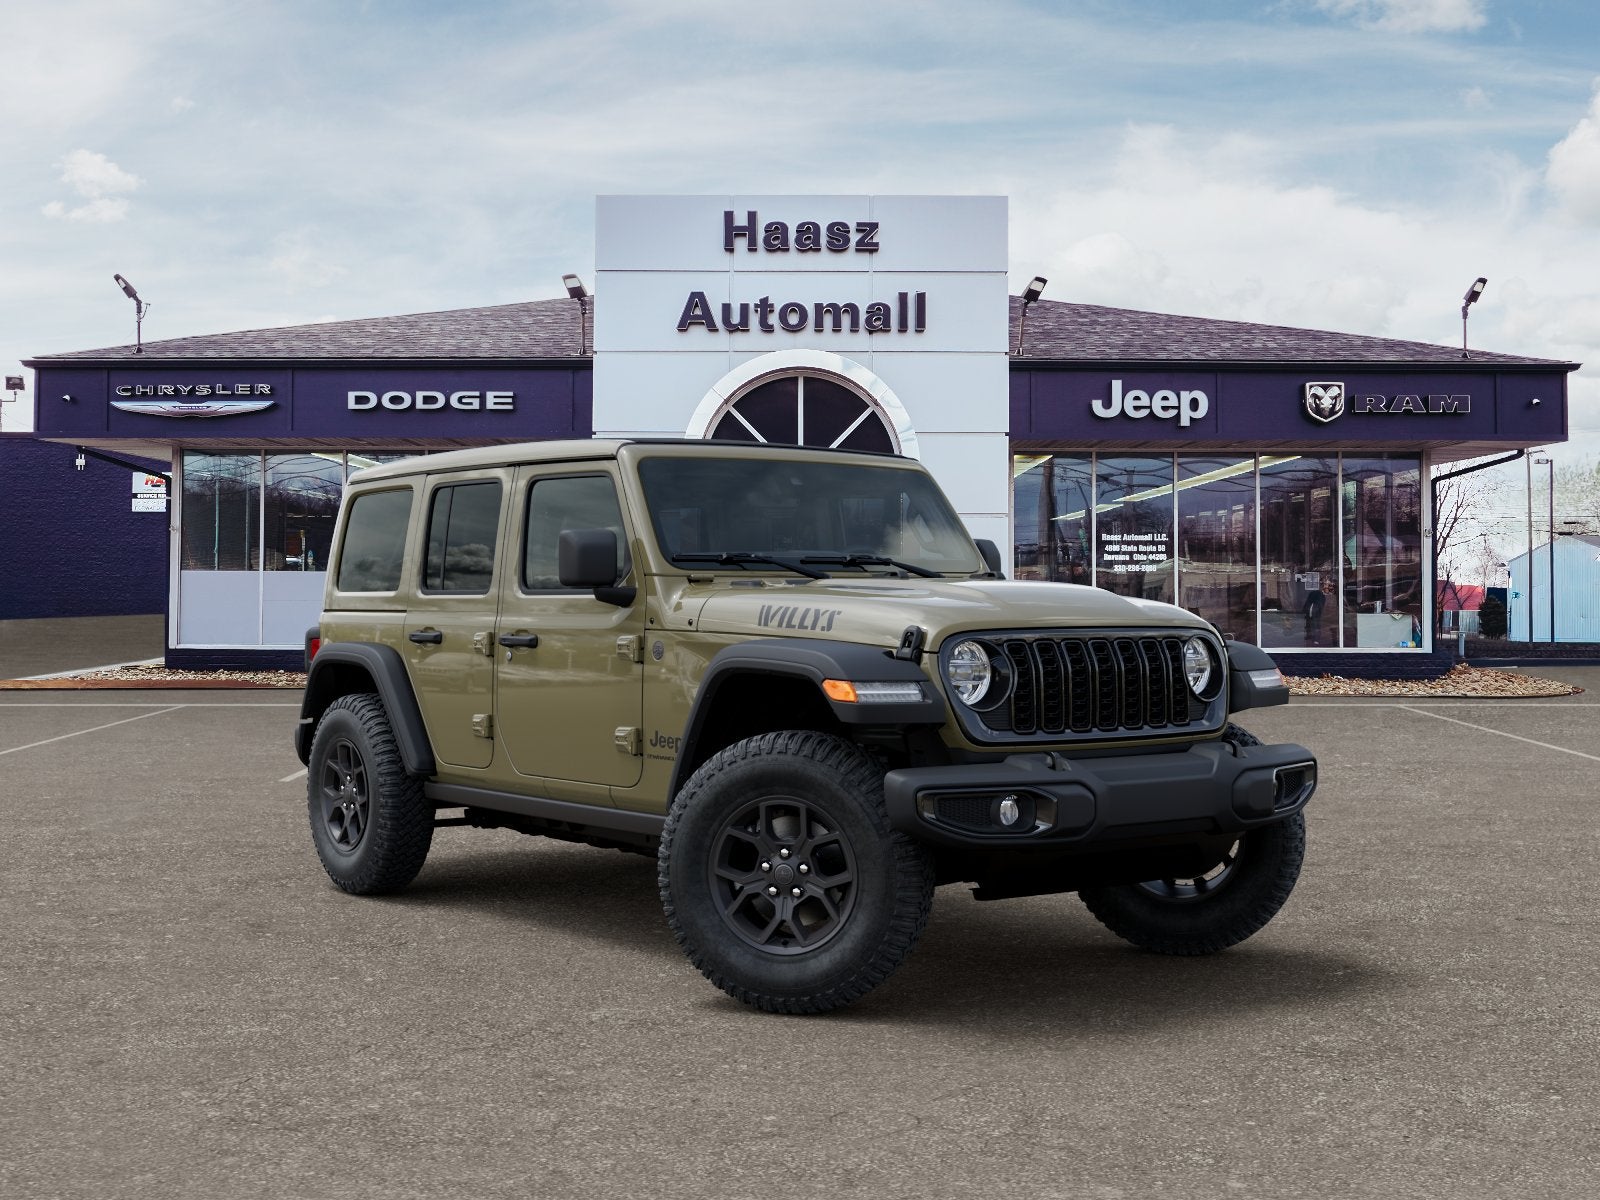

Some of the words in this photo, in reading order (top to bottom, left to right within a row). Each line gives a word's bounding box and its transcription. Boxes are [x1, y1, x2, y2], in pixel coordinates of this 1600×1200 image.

[723, 210, 880, 252] Haasz
[676, 291, 927, 333] Automall
[115, 383, 271, 396] CHRYSLER
[347, 390, 515, 411] DODGE
[1091, 379, 1209, 427] Jeep
[1354, 394, 1471, 413] RAM
[1122, 533, 1153, 541] Automall
[1120, 544, 1138, 552] State
[1138, 544, 1157, 552] Route
[1132, 553, 1147, 561] Ohio
[757, 604, 843, 632] WILLYS
